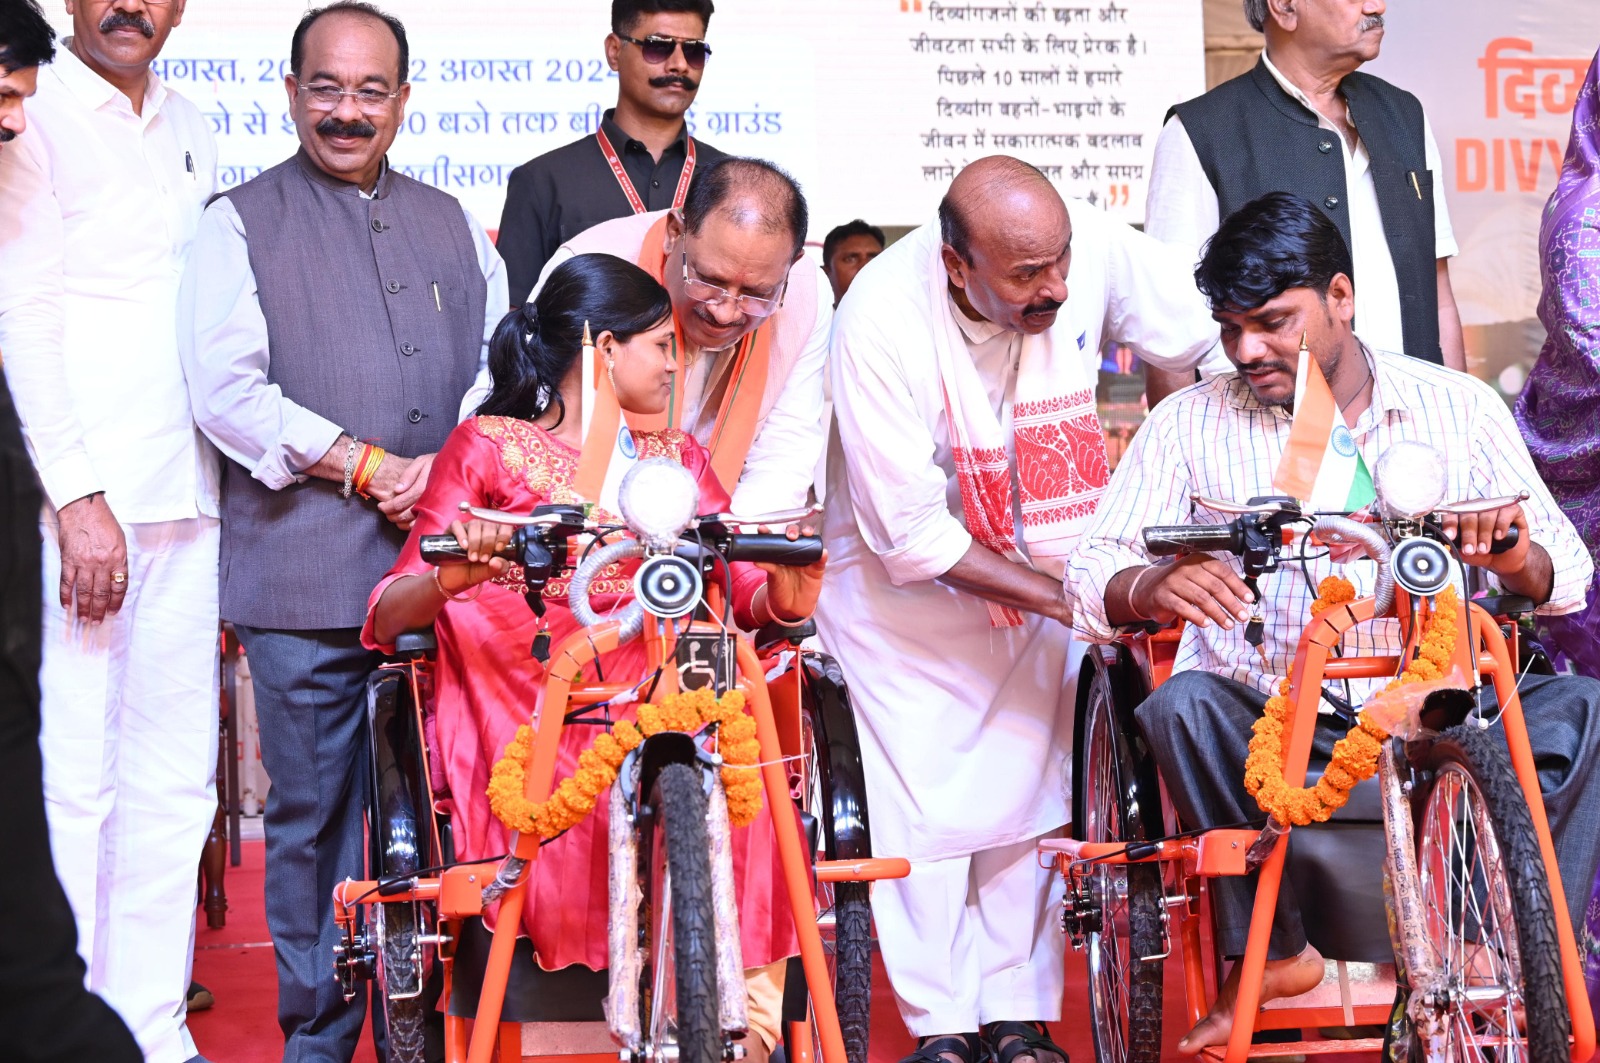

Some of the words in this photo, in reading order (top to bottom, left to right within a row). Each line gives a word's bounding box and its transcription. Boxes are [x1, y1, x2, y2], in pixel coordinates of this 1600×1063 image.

[1024, 2, 1046, 21] की
[1100, 1, 1127, 22] और
[910, 32, 974, 53] जीवटता
[981, 33, 1016, 52] सभी
[1022, 33, 1039, 53] के
[1045, 34, 1078, 57] लिए
[1083, 33, 1120, 53] प्रेरक
[440, 59, 533, 82] अगस्त
[937, 64, 986, 85] पिछले
[994, 71, 1012, 86] 10
[1019, 65, 1060, 84] सालों
[1066, 65, 1078, 83] में
[1084, 65, 1122, 87] हमारे
[242, 100, 268, 136] से
[436, 100, 491, 135] बजे
[500, 111, 560, 135] तक
[937, 97, 992, 117] दिव्यांग
[1109, 97, 1125, 116] के
[921, 129, 967, 148] जीवन
[973, 129, 985, 147] में
[992, 134, 1079, 148] सकारात्मक
[921, 159, 955, 180] लाने
[1071, 159, 1100, 179] और
